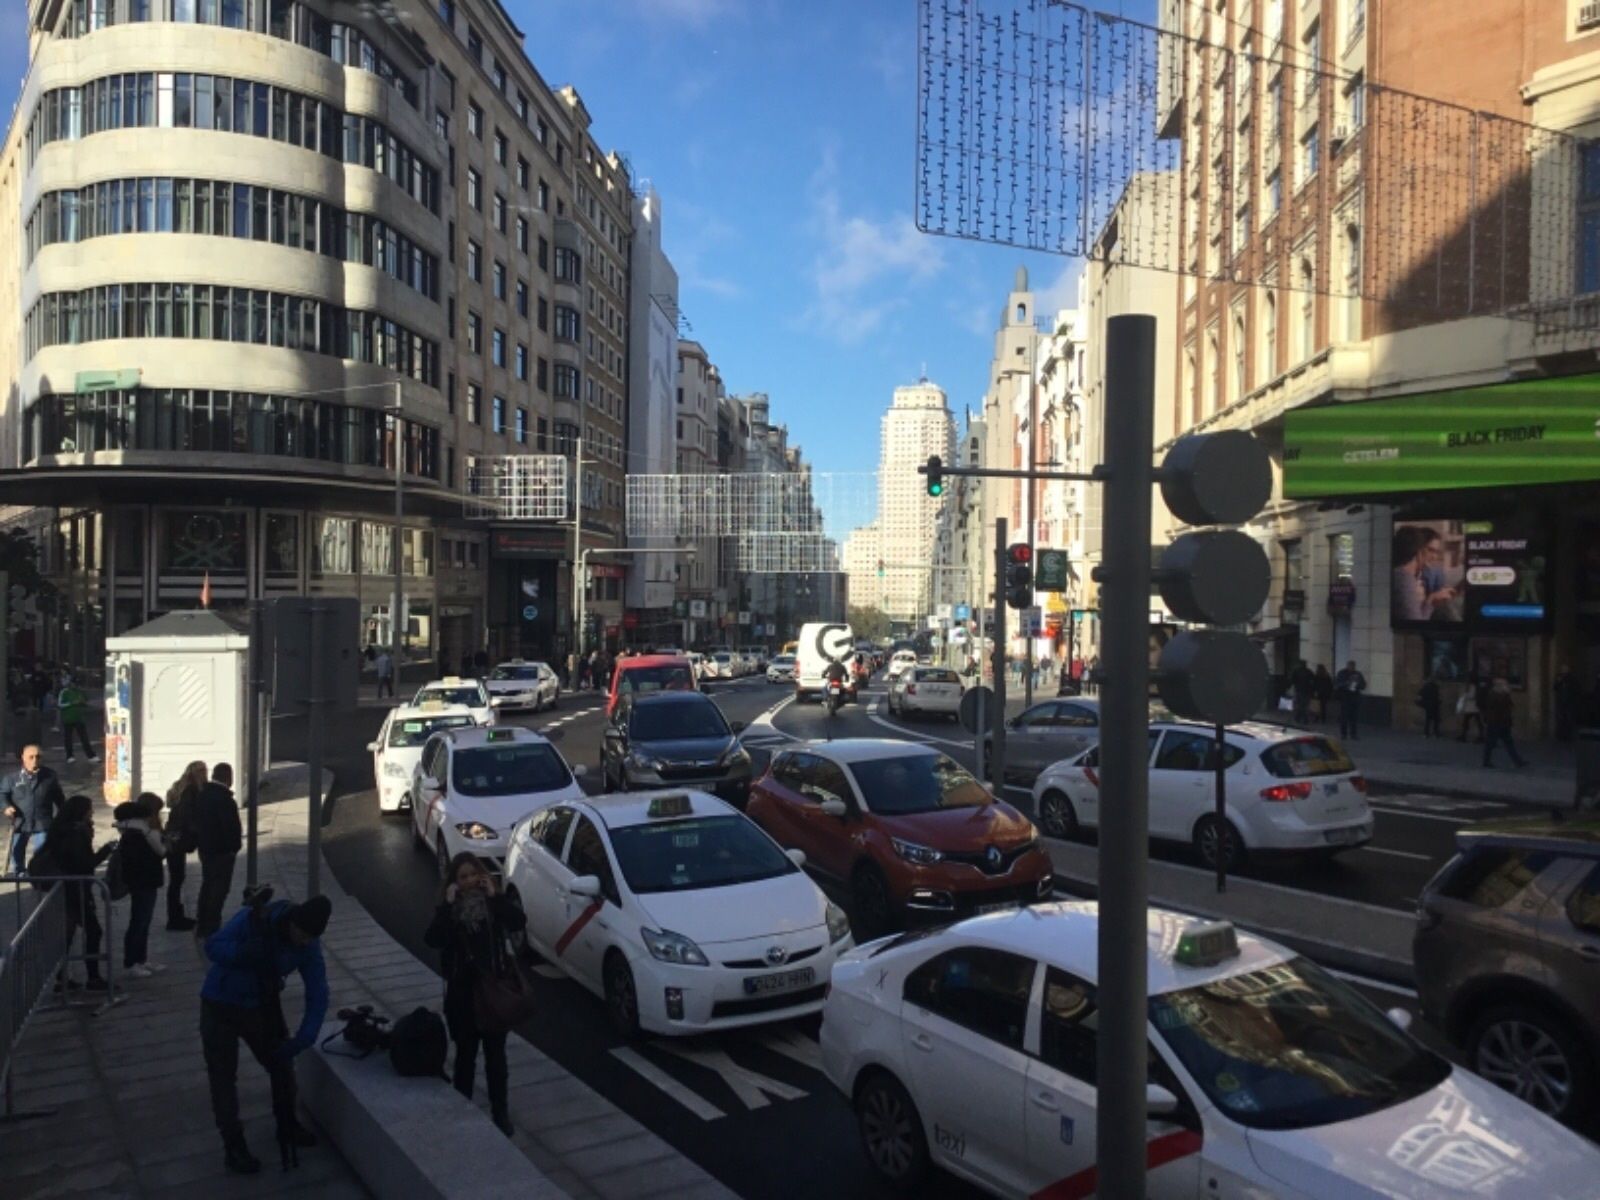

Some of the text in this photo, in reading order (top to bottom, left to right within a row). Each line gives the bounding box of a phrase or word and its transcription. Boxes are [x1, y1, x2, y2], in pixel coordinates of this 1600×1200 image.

[1447, 424, 1546, 448] BLACK FRIDAY
[1468, 539, 1528, 550] BLACK FRIDAY
[934, 1122, 966, 1157] taxi
